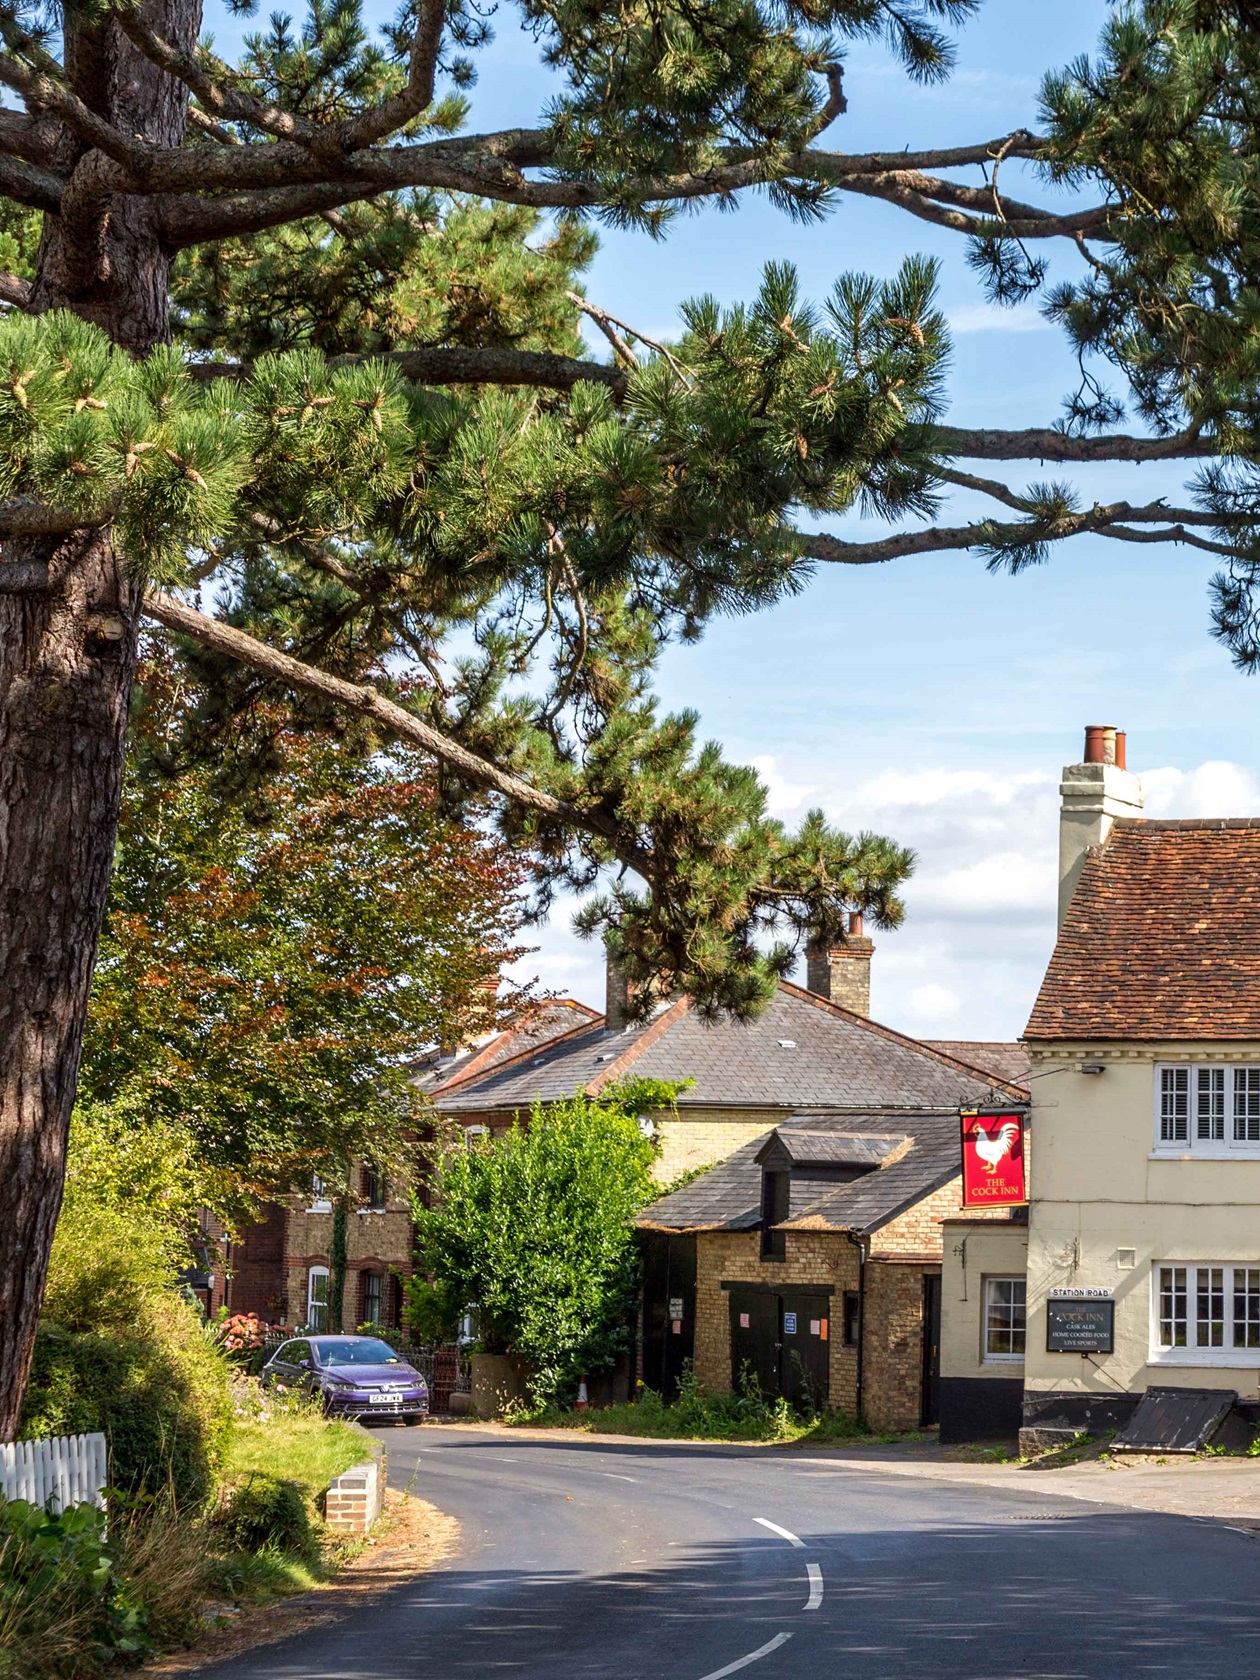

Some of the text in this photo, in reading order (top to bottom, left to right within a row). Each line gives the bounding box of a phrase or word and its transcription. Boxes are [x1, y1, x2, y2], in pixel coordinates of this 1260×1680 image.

[986, 1178, 1005, 1186] THE
[972, 1186, 1018, 1196] COCK INN
[1053, 1289, 1085, 1297] STATION
[1058, 1312, 1104, 1322] COCK INN
